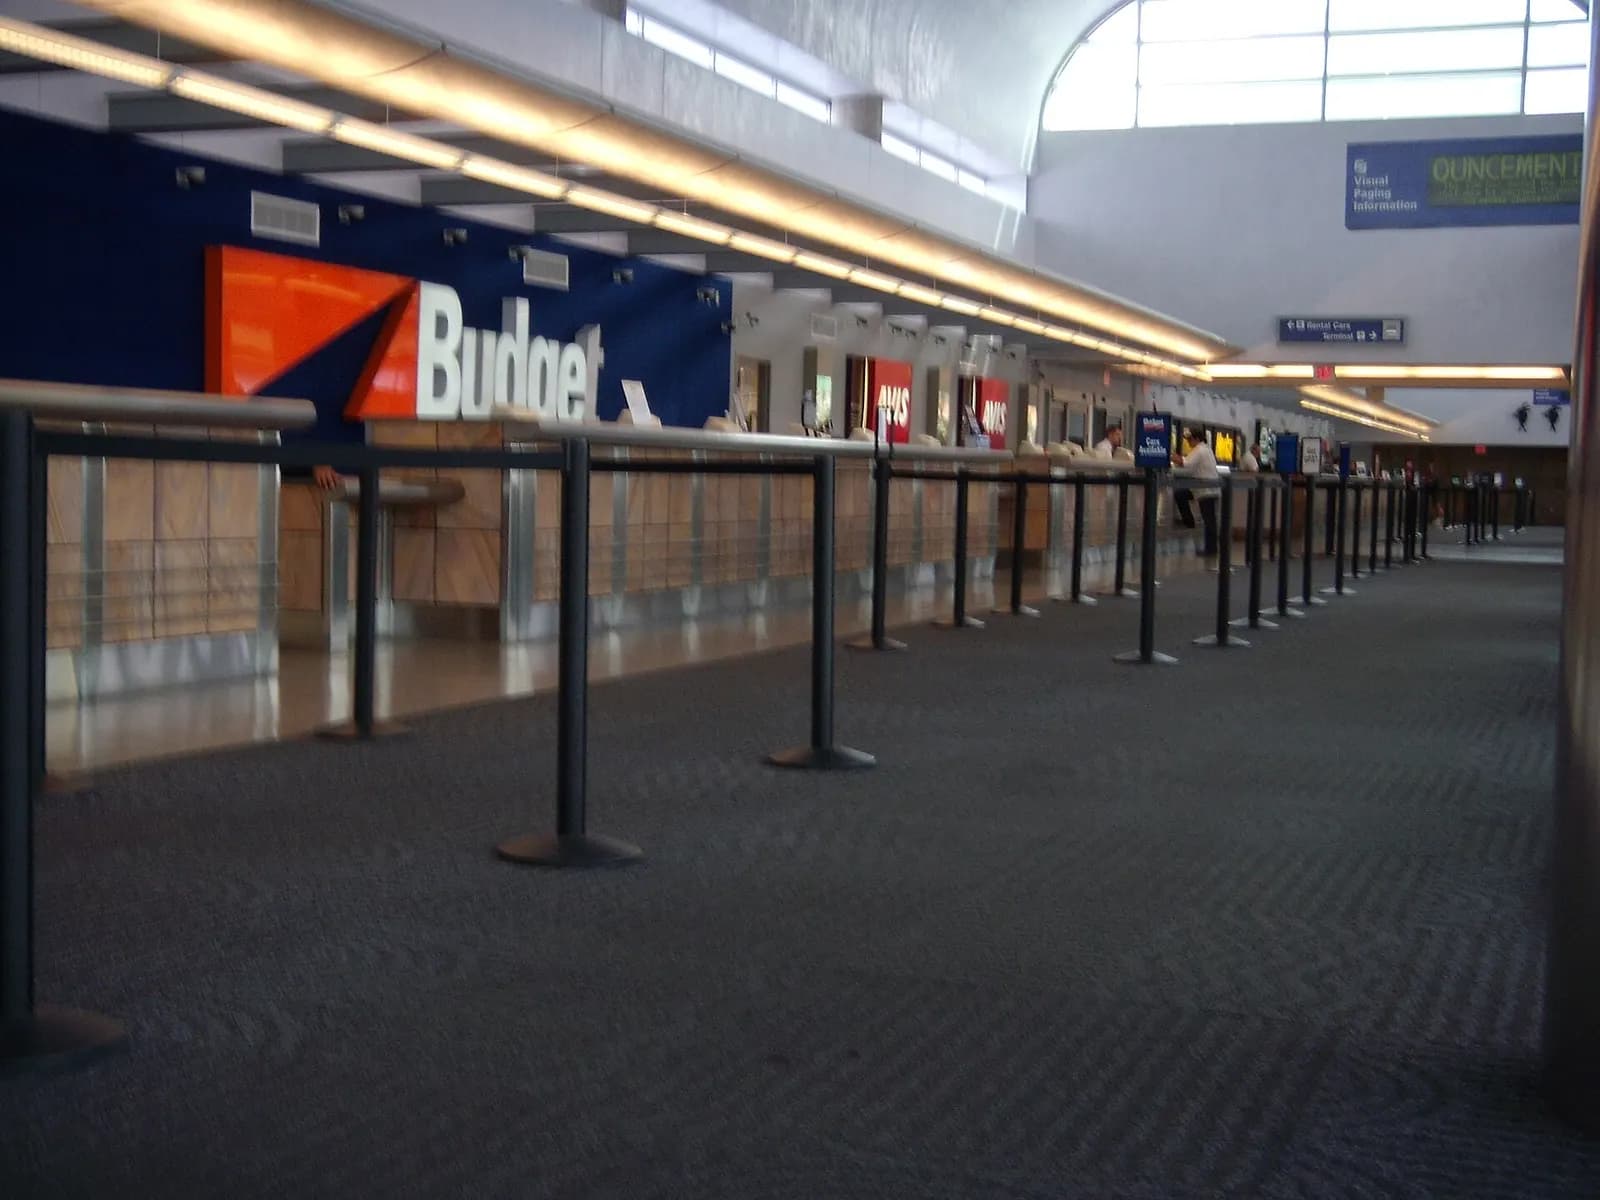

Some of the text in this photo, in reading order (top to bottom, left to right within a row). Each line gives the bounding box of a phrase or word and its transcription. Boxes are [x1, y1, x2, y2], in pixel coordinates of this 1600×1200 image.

[1354, 175, 1389, 185] Visual
[1354, 188, 1392, 200] Paging
[1354, 200, 1418, 211] Information
[1323, 332, 1353, 341] Terminal
[416, 280, 604, 425] Budget
[877, 384, 910, 428] AVIS
[983, 400, 1007, 434] AVIS
